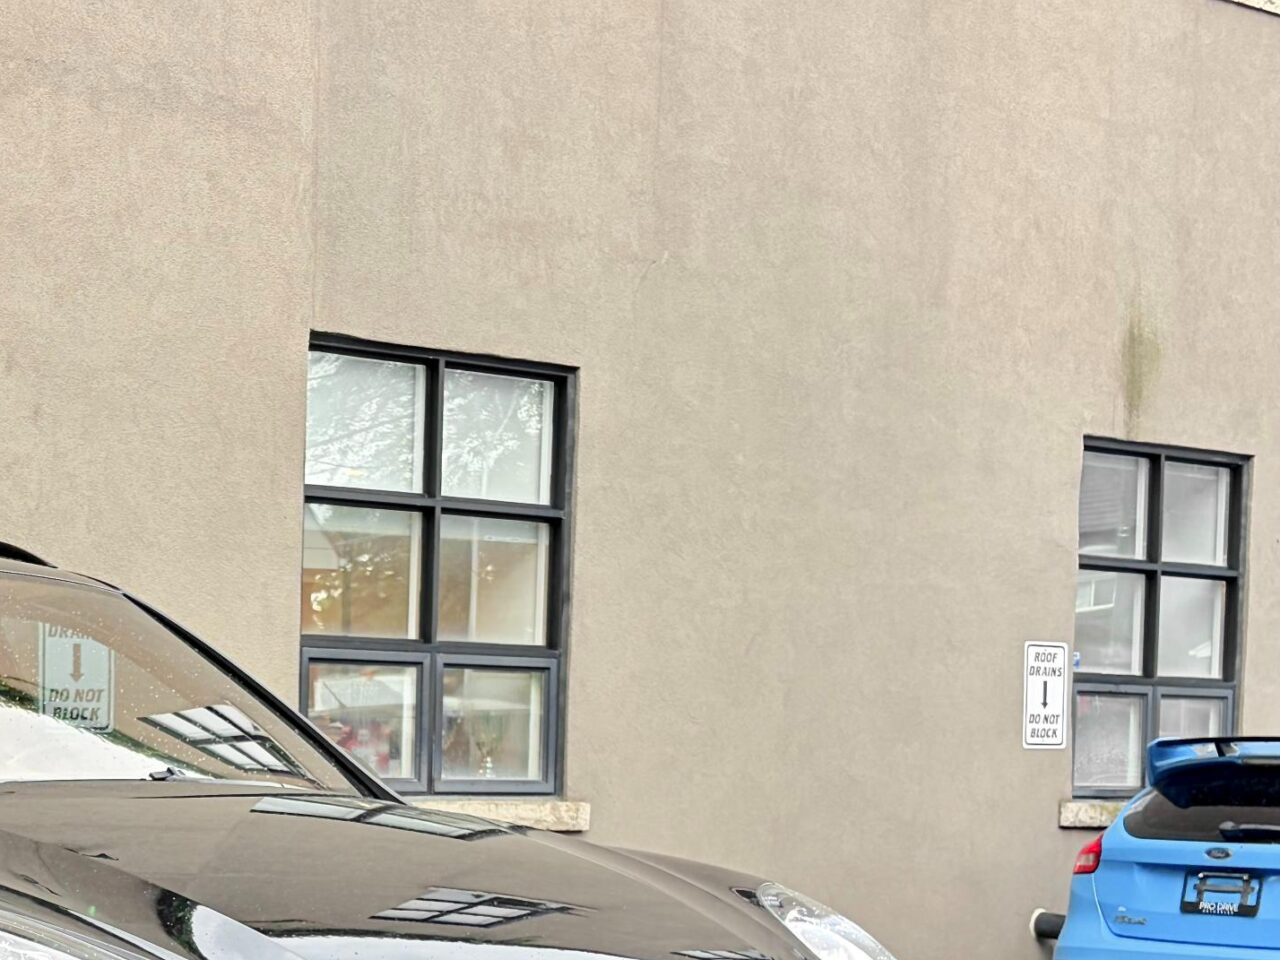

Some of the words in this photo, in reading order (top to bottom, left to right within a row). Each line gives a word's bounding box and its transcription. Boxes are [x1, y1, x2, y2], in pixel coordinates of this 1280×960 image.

[1034, 651, 1058, 663] ROOF
[1029, 665, 1062, 677] DRAINS
[49, 688, 70, 703] DO
[73, 688, 105, 703] NOT
[53, 706, 101, 721] BLOCK
[1029, 713, 1041, 724] DO
[1042, 714, 1061, 725] NOT
[1030, 727, 1058, 738] BLOCK
[1199, 901, 1216, 911] PRO
